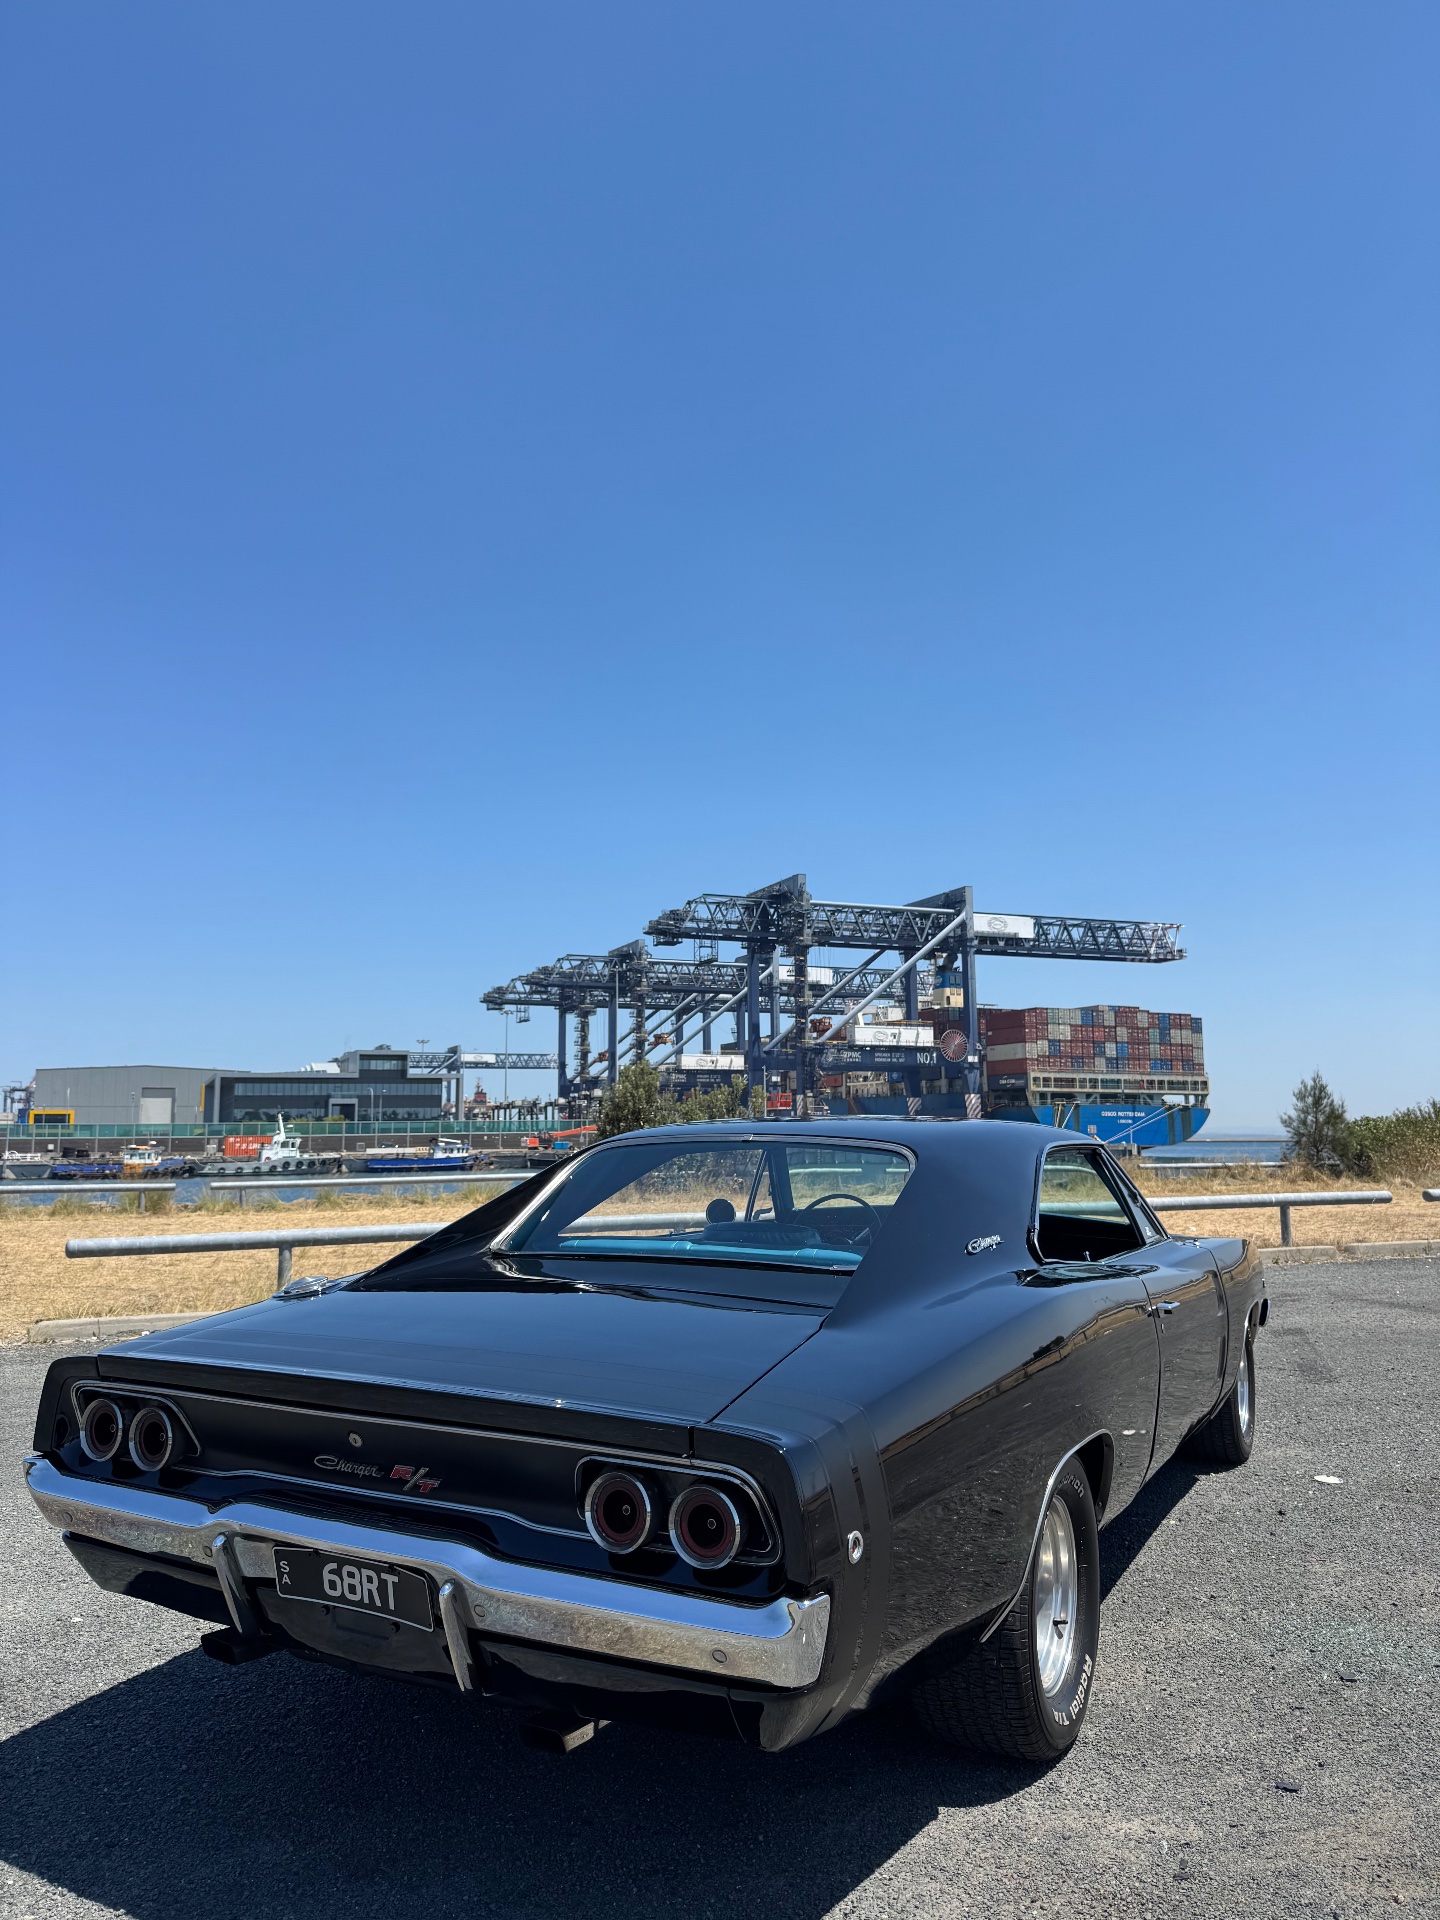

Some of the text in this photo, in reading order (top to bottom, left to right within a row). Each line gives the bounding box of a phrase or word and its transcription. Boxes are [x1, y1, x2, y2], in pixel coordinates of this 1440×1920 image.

[917, 1052, 937, 1064] NO.1
[313, 1454, 442, 1493] Charger R/T
[322, 1562, 399, 1611] 68RT
[1069, 1653, 1093, 1720] Radial
